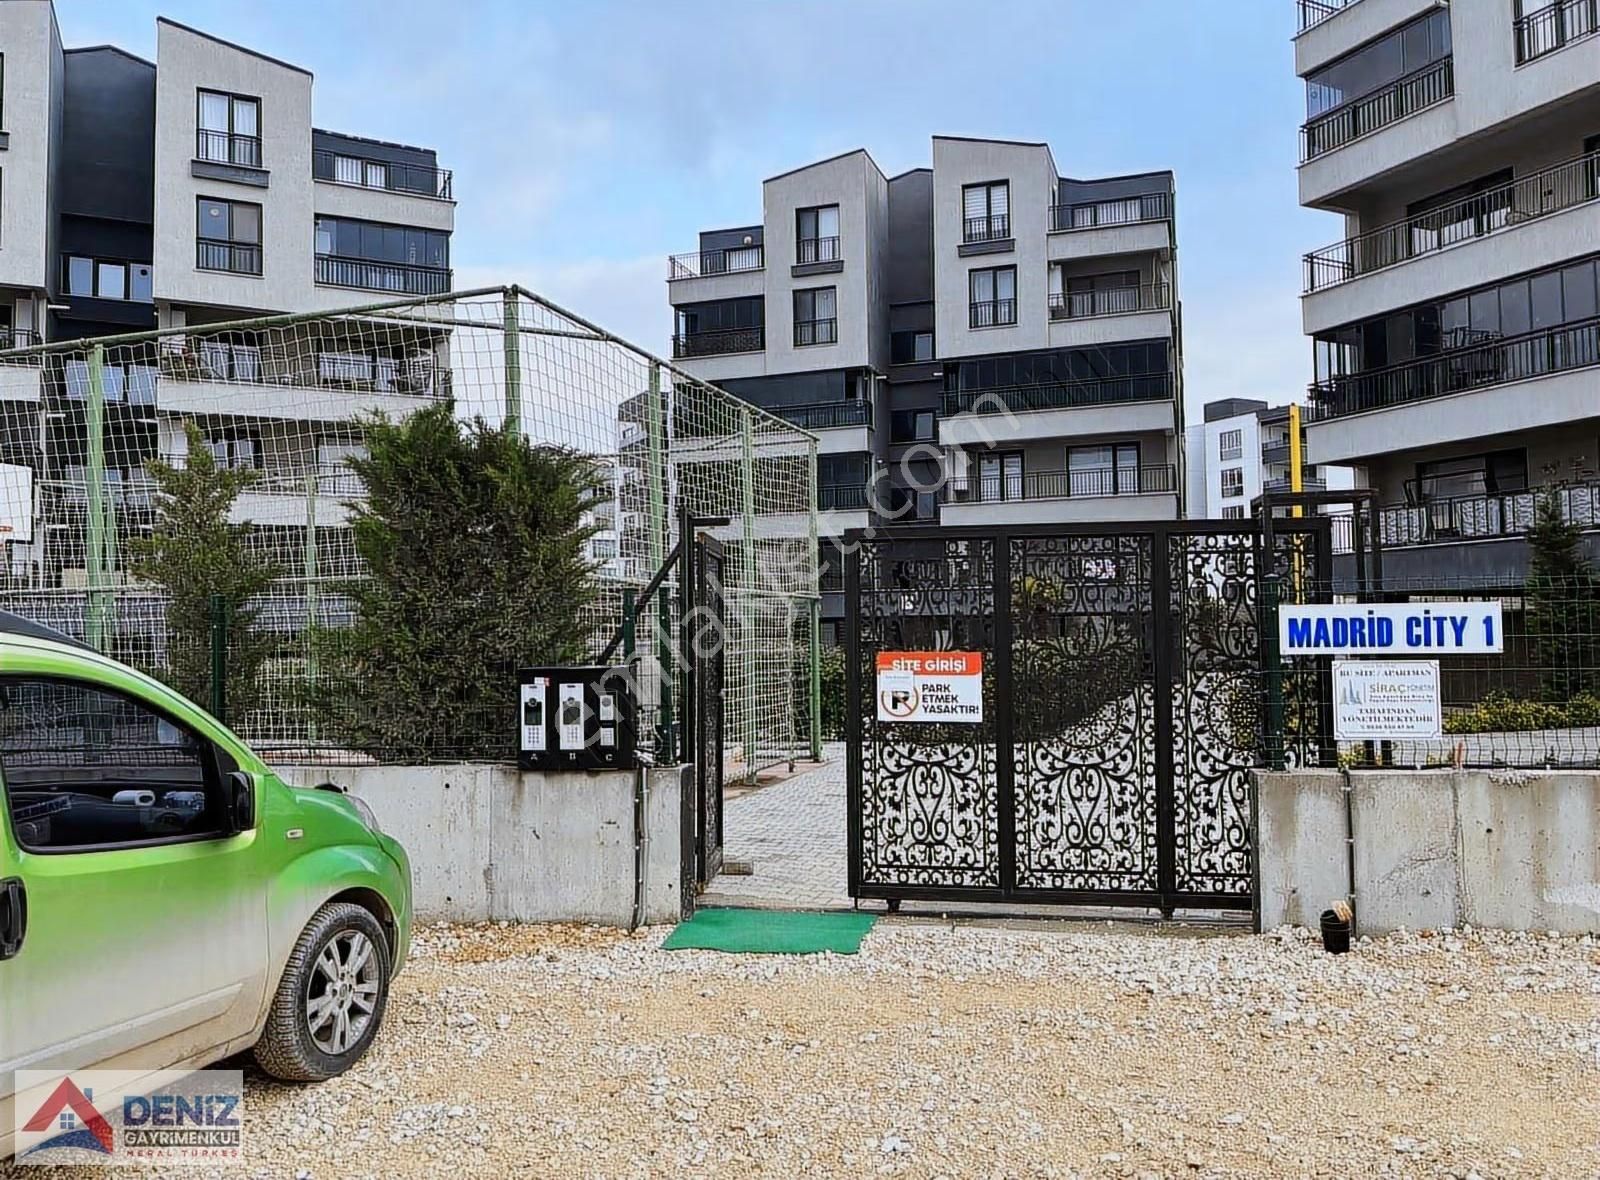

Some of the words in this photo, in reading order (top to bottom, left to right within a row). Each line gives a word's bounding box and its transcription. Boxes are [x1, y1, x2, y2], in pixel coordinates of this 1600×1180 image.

[1482, 615, 1494, 647] 1
[925, 656, 967, 673] GİRİŞİ
[921, 683, 951, 693] PARK
[921, 694, 959, 704] ETMEK
[921, 704, 979, 715] YASAKTIR!
